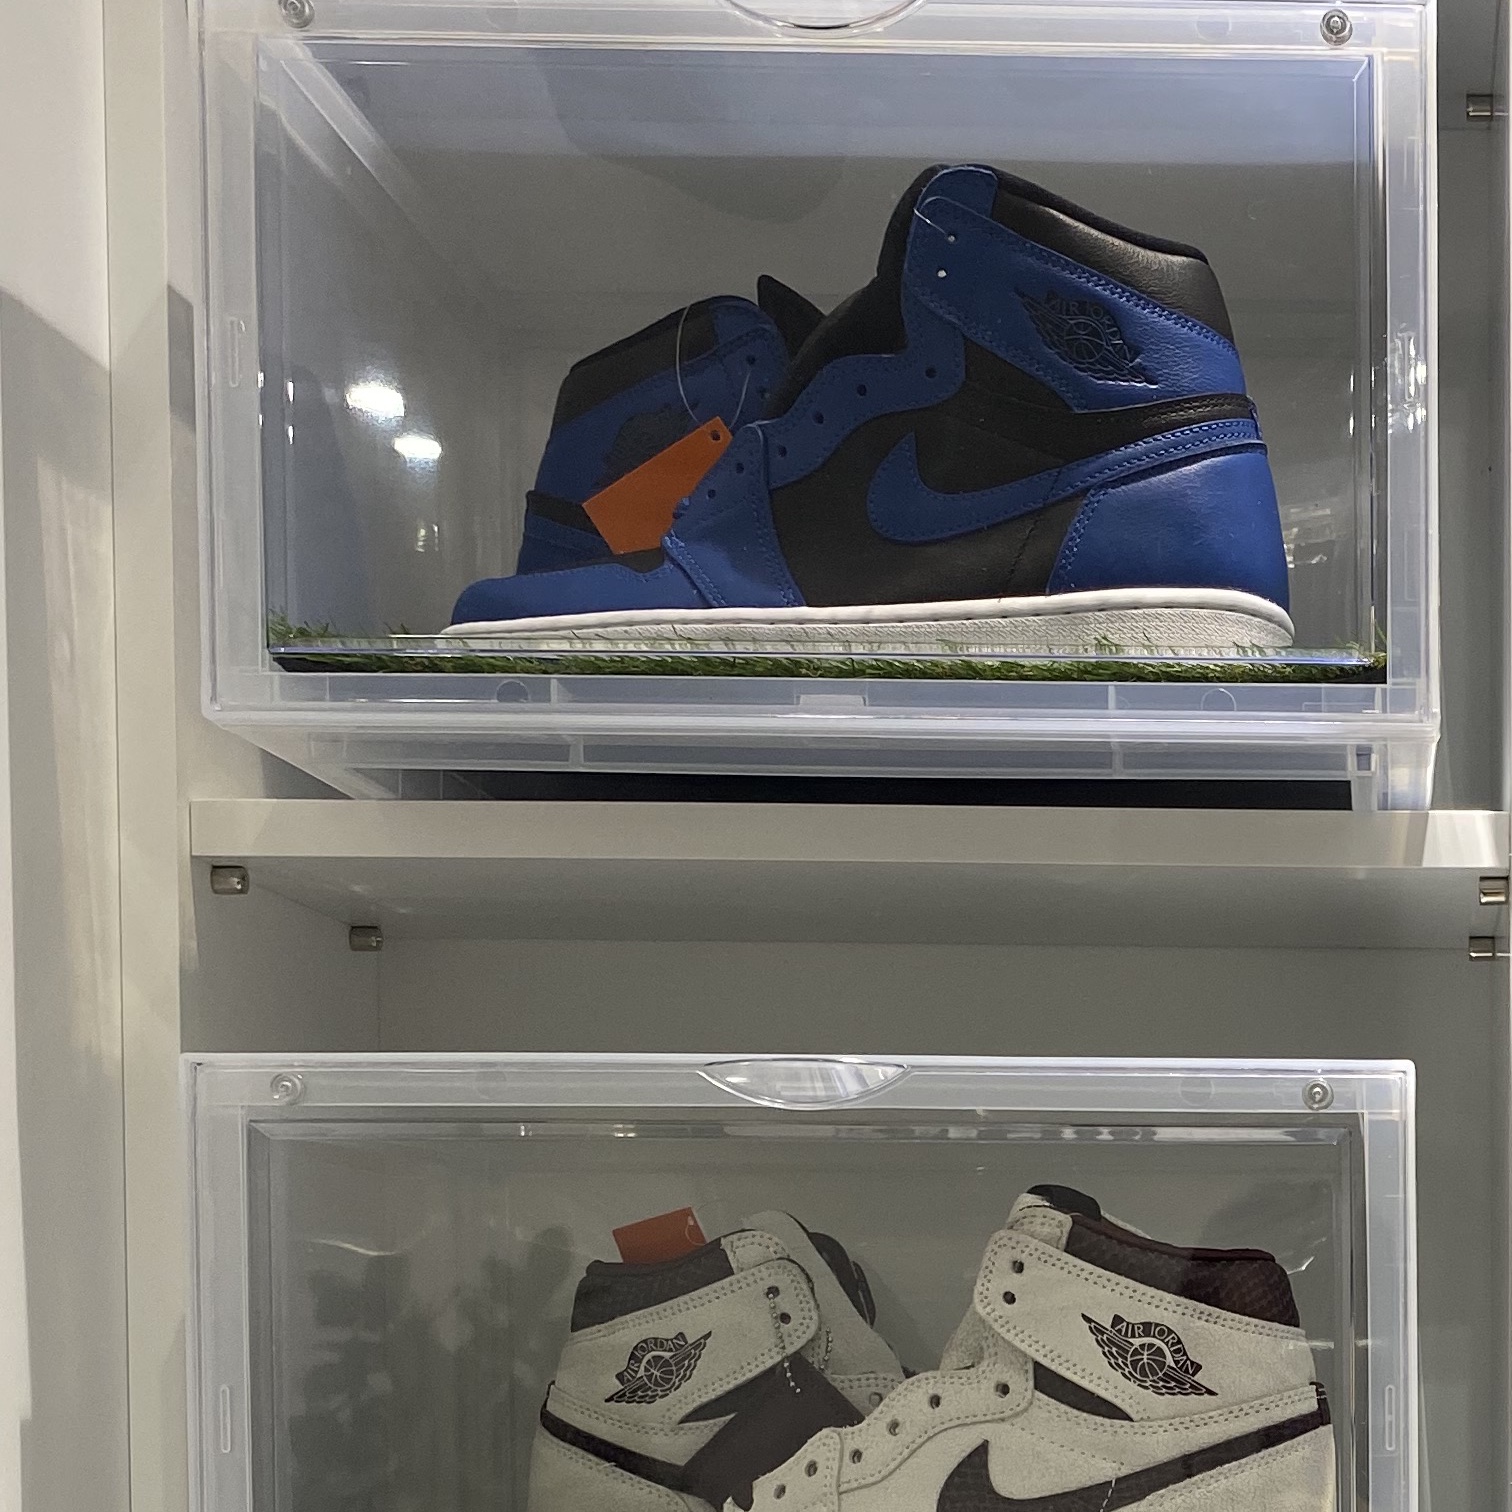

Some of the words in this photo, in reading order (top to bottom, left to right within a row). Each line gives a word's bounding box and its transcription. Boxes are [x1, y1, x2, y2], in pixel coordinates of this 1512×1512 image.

[622, 1358, 642, 1384] AIR
[635, 1336, 686, 1360] JORDAN
[1115, 1320, 1145, 1337] AIR
[1150, 1322, 1197, 1376] JORDAN
